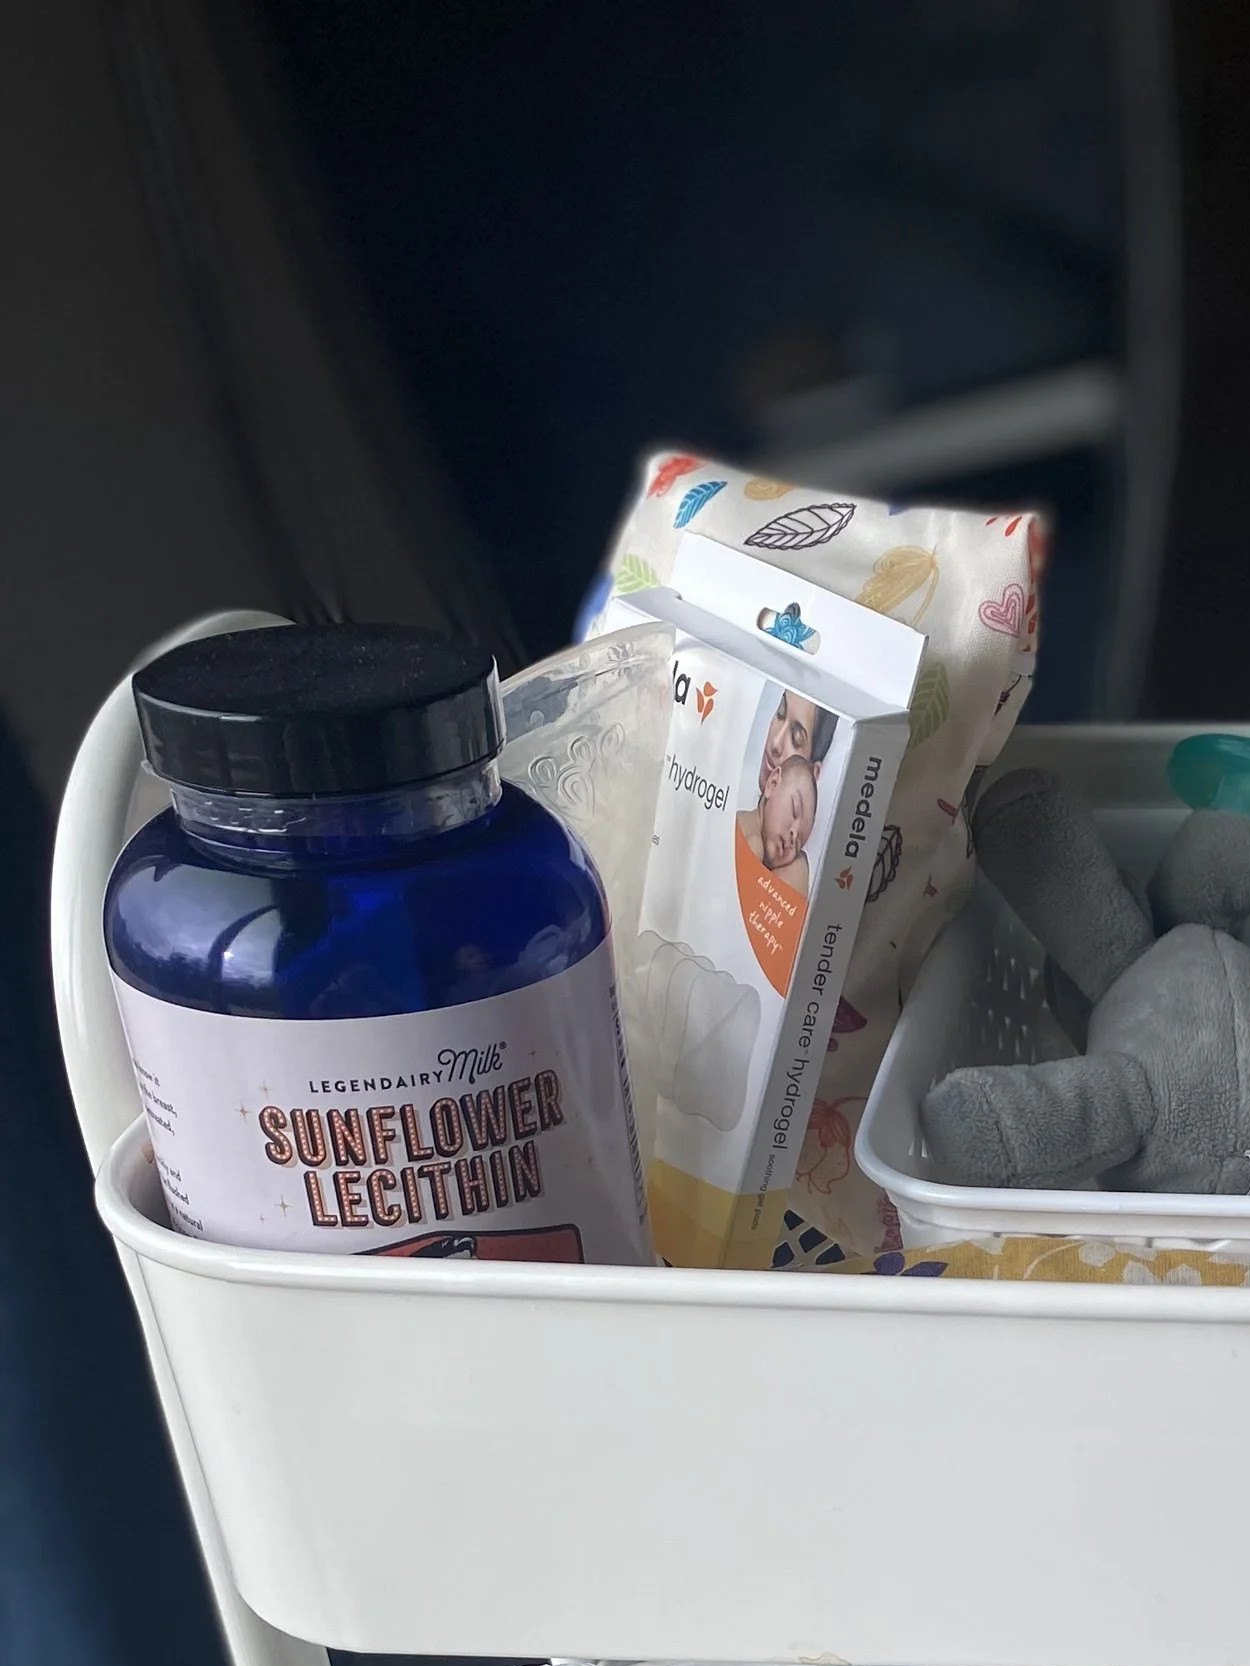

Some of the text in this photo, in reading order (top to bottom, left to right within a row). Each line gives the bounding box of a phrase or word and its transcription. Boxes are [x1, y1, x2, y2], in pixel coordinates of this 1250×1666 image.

[668, 754, 730, 811] hydrogel
[844, 756, 883, 859] medela
[757, 876, 797, 917] advanced
[759, 901, 784, 928] nipple
[772, 923, 843, 1150] tender care hydrogel
[257, 1068, 564, 1168] SUNFLOWER
[308, 1070, 444, 1094] LEGENDAIRY
[303, 1140, 542, 1228] LECITHIN
